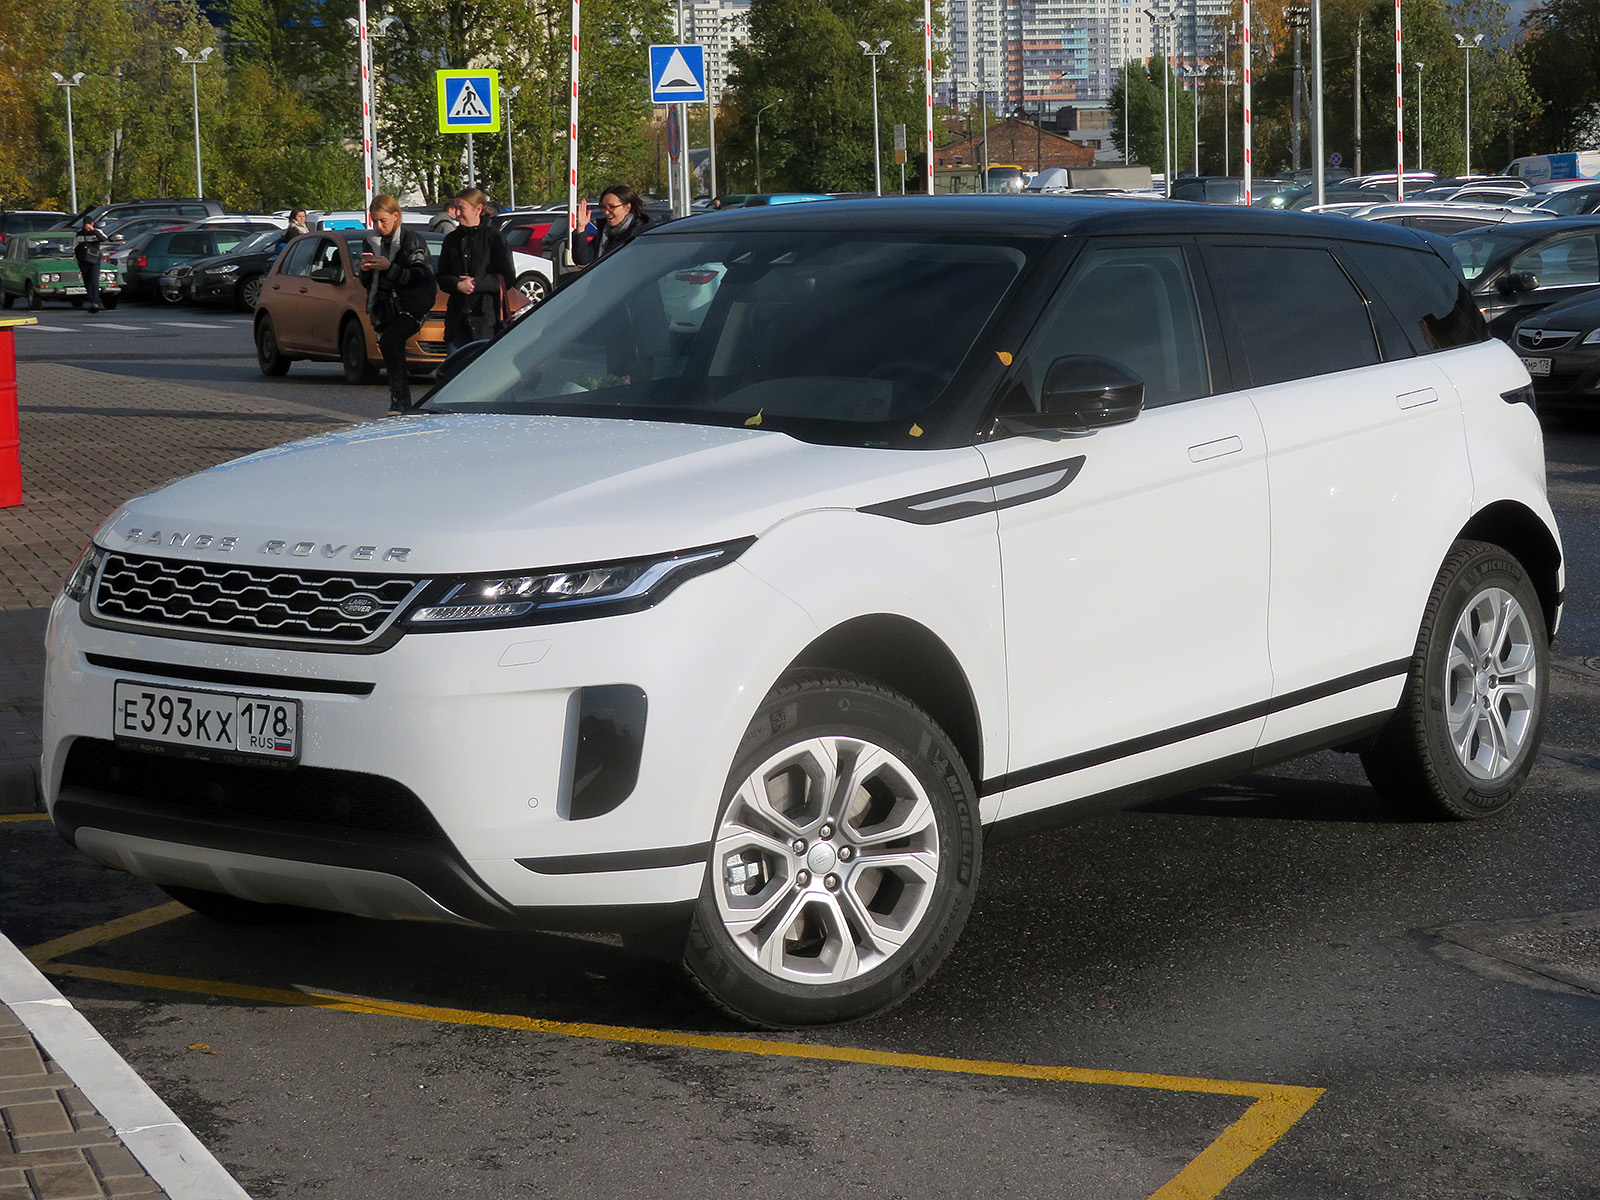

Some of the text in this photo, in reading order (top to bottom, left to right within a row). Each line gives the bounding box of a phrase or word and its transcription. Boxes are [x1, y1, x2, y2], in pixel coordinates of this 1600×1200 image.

[125, 528, 413, 563] RANGE ROVER
[1480, 560, 1521, 578] MICHELIN
[240, 703, 287, 737] 178
[250, 736, 274, 749] RUS
[946, 775, 973, 885] MICHELIN
